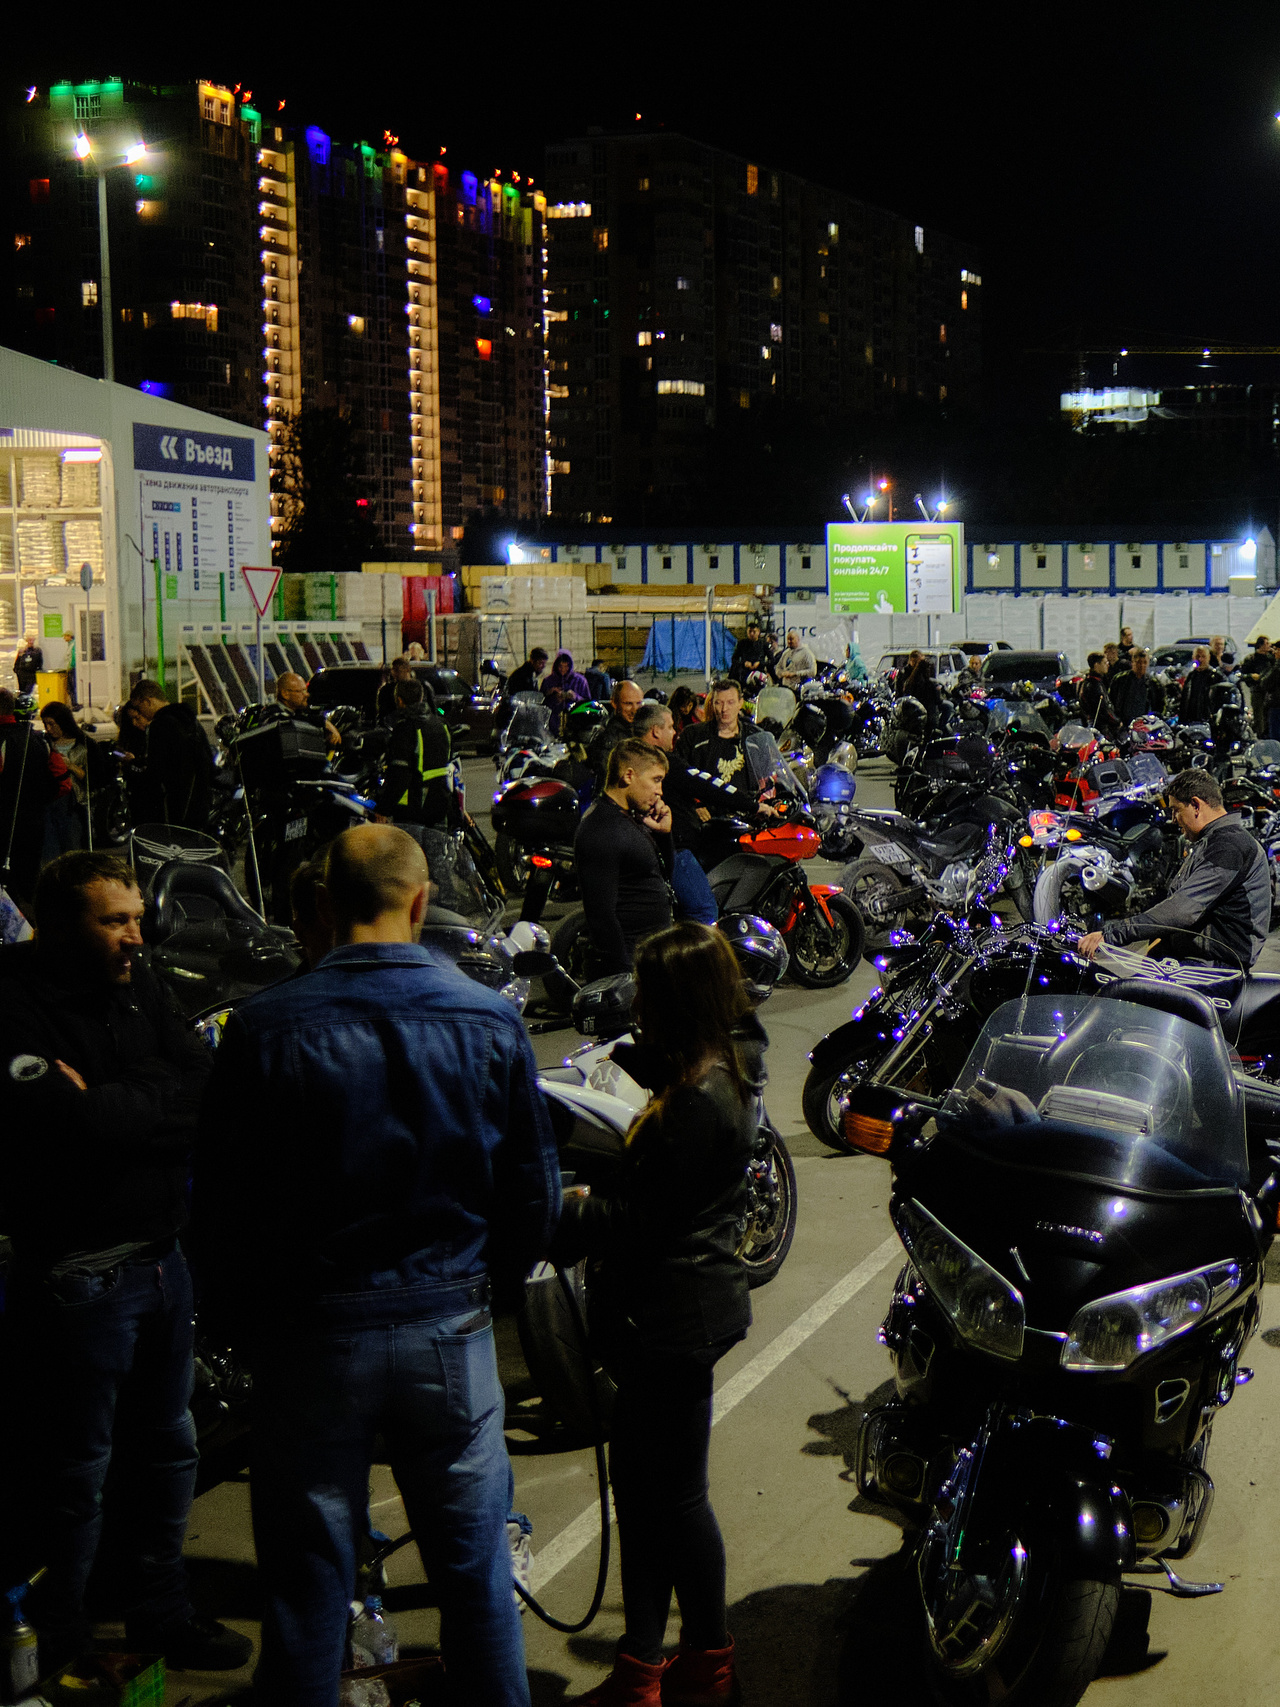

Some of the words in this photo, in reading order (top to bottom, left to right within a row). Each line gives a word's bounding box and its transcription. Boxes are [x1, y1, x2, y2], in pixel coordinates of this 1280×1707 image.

[185, 438, 233, 471] Въезд
[833, 543, 898, 553] Продолжайте
[833, 556, 876, 565] покупать
[833, 566, 868, 575] онлайн
[869, 566, 889, 575] 24/7
